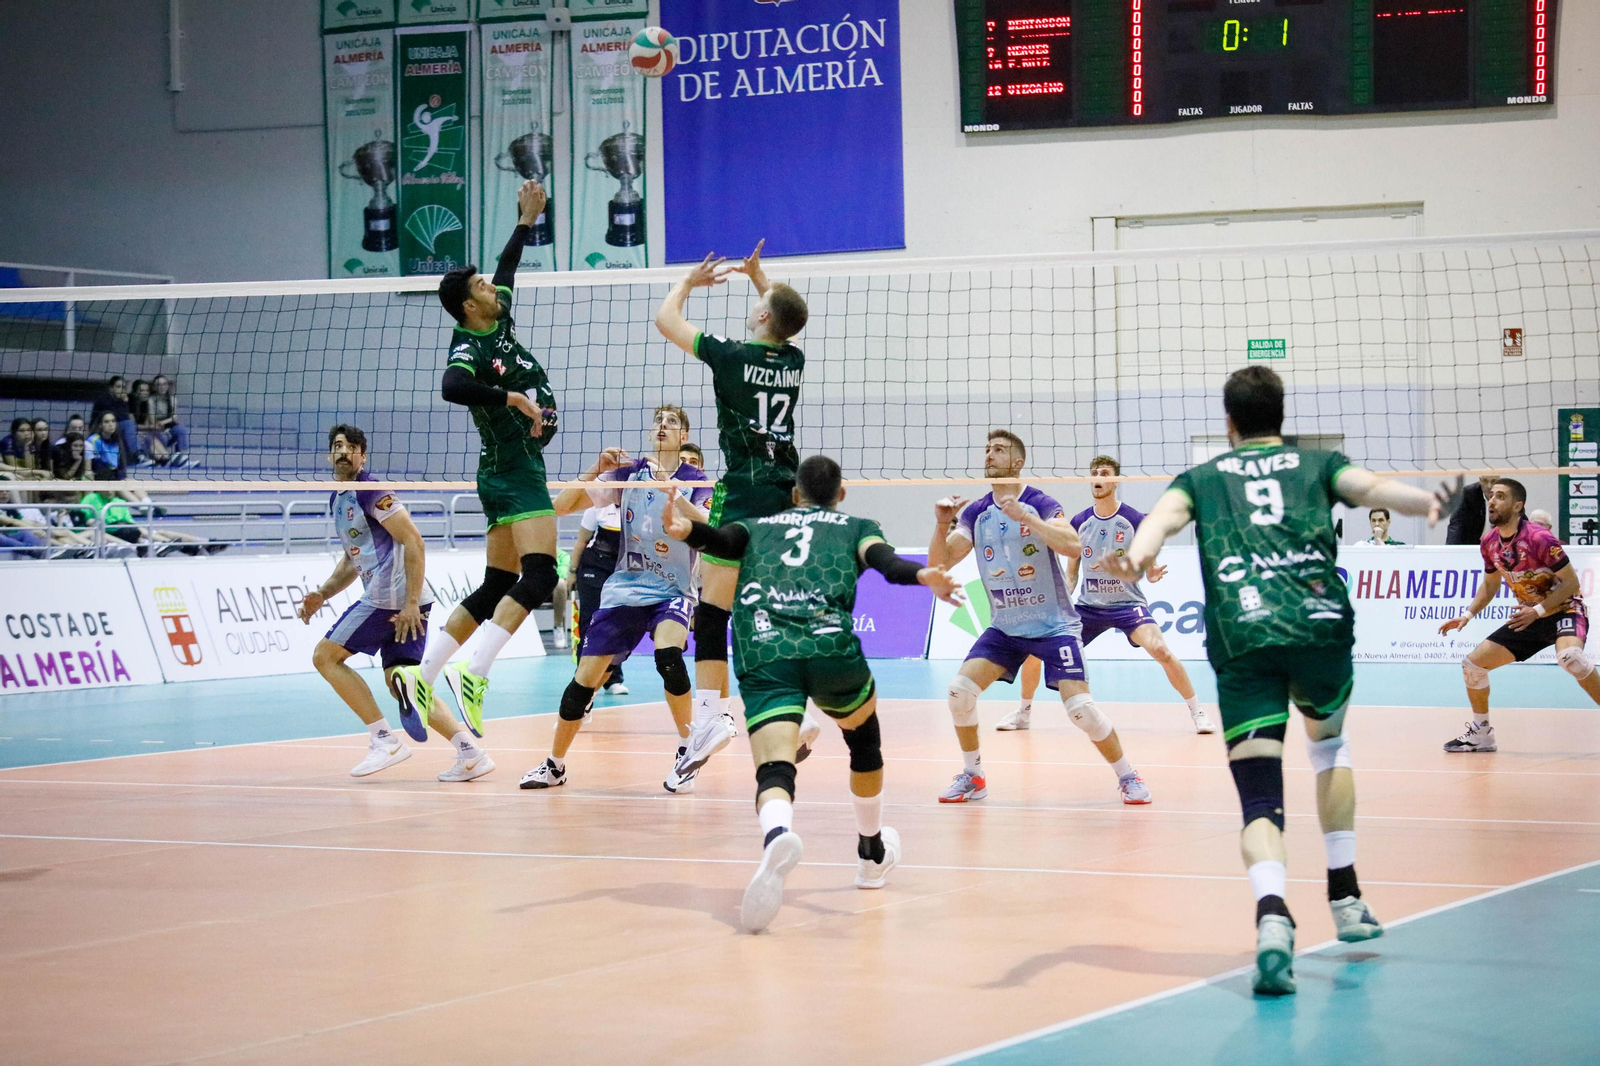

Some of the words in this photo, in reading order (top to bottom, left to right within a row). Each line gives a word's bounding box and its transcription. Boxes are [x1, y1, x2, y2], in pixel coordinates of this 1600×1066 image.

[492, 28, 540, 40] UNICAJA
[583, 27, 632, 39] UNICAJA
[675, 13, 887, 65] DIPUTACIÓN
[336, 37, 381, 50] UNICAJA
[490, 42, 542, 54] ALMERÍA
[334, 50, 384, 64] ALMERÍA
[408, 46, 459, 59] UNICAJA
[405, 60, 462, 76] ALMERÍA
[677, 71, 722, 102] DE
[730, 51, 884, 98] ALMERÍA
[1288, 102, 1314, 110] FALTAS
[1507, 95, 1547, 104] MONDO
[1178, 107, 1203, 116] FALTAS
[1229, 105, 1262, 114] JUGADOR
[964, 124, 999, 132] MONDO
[411, 256, 458, 273] Unicaja
[606, 260, 633, 269] Unicaja
[1251, 341, 1273, 349] SALIDA
[1274, 340, 1283, 348] DE
[1250, 349, 1285, 358] EMERGENCIA
[743, 364, 800, 388] VIZCAÍNO
[753, 391, 791, 432] 12
[1216, 452, 1300, 477] NEAVES
[1244, 478, 1285, 526] 9
[780, 525, 814, 566] 3
[1357, 570, 1400, 599] HLA
[1007, 594, 1046, 609] Herce
[1404, 606, 1417, 620] TU
[1420, 606, 1456, 620] SALUD
[6, 612, 82, 639] COSTA
[82, 611, 114, 636] DE
[225, 630, 290, 655] CIUDAD
[1400, 641, 1445, 649] @GrupoHLA
[1059, 646, 1074, 666] 9
[0, 640, 131, 688] ALMERÍA
